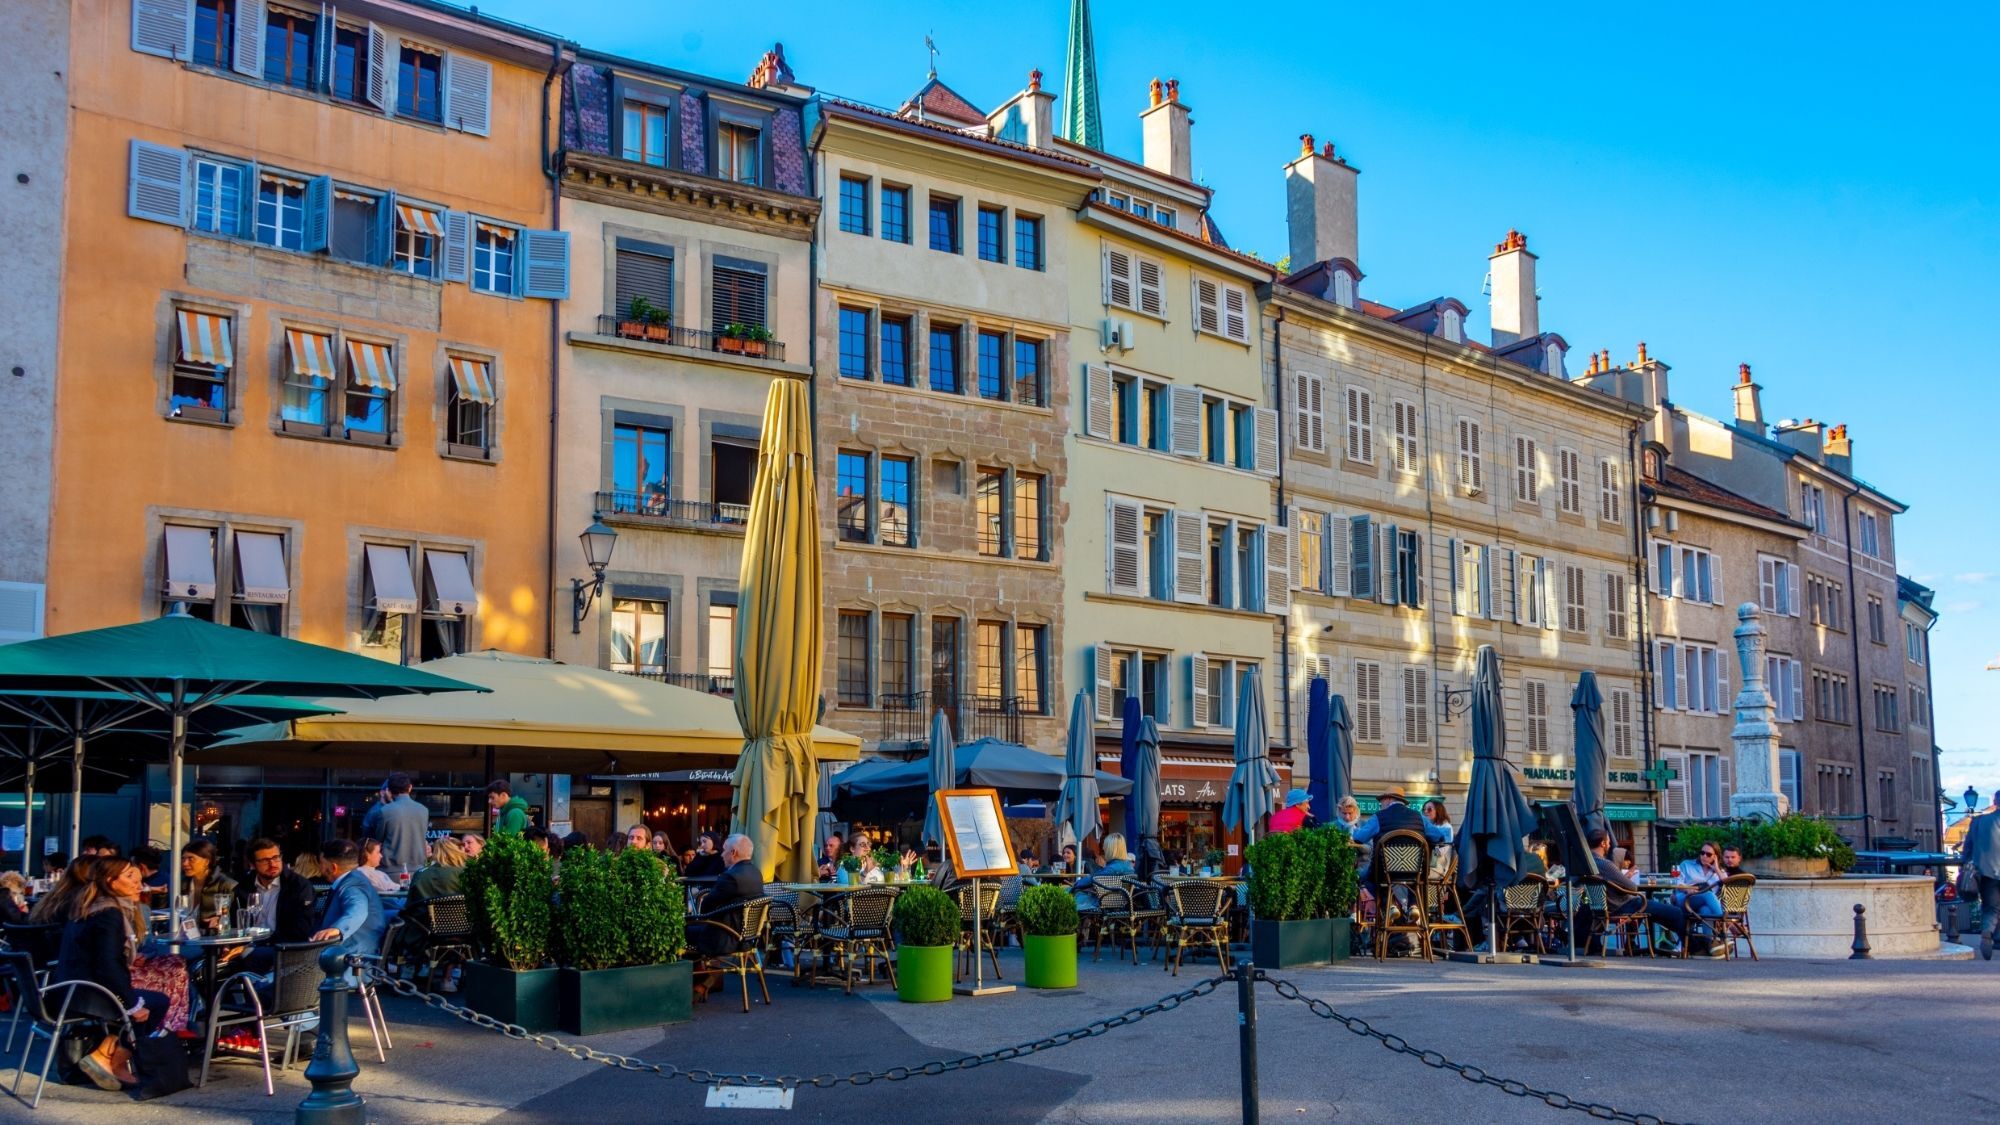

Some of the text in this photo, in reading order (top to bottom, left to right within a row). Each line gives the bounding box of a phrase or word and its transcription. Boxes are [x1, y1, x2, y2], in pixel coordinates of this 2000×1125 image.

[247, 591, 286, 599] RESTAURANT
[1523, 767, 1568, 781] PHARMACIE
[1608, 771, 1619, 782] DE
[1620, 772, 1638, 783] FOUR
